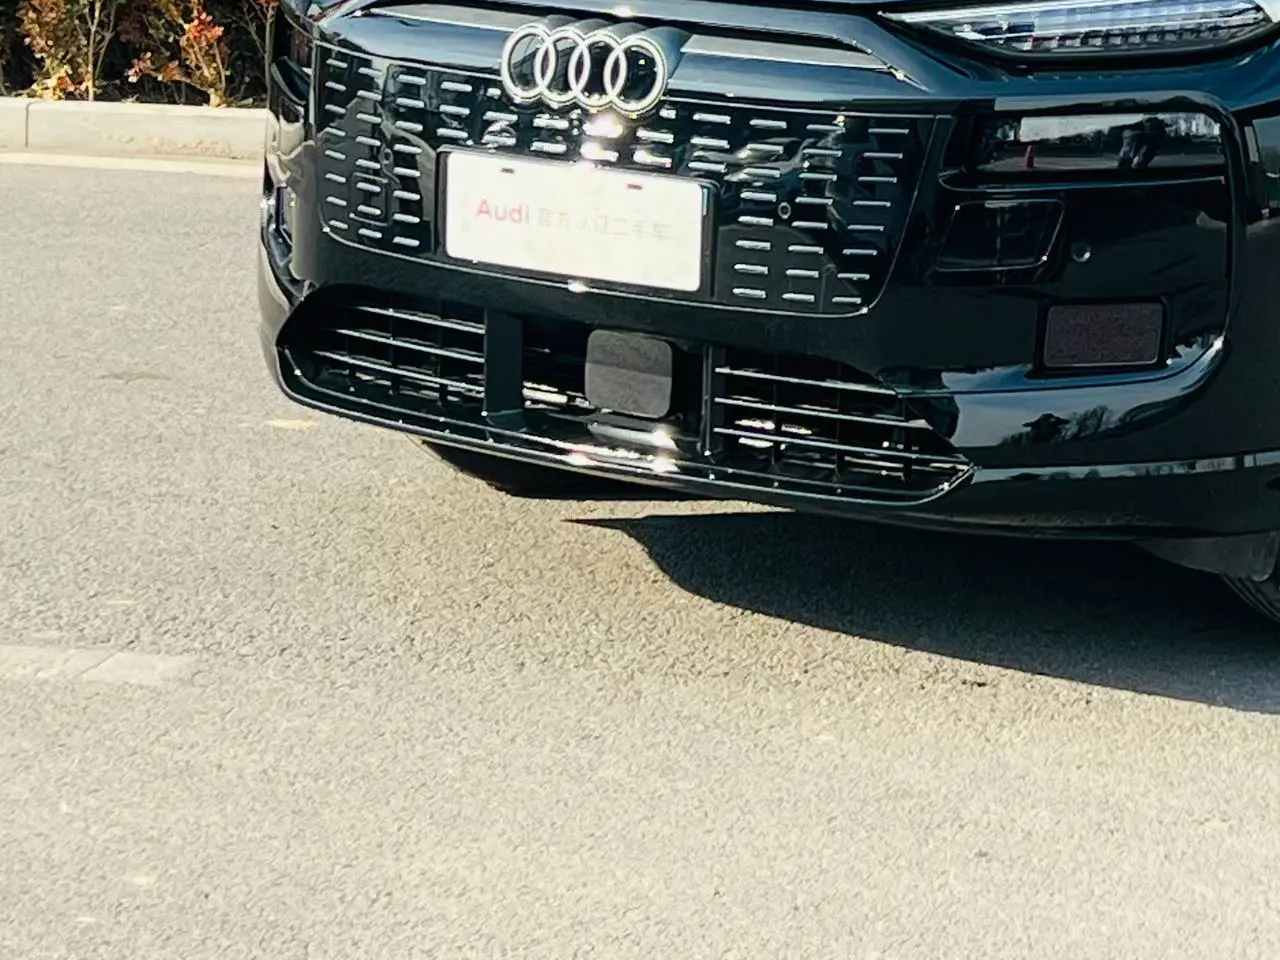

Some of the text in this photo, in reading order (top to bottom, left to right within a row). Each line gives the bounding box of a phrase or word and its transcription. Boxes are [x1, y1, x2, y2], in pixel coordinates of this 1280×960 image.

[476, 197, 530, 224] Audi
[537, 205, 673, 241] 官方认证二手车
